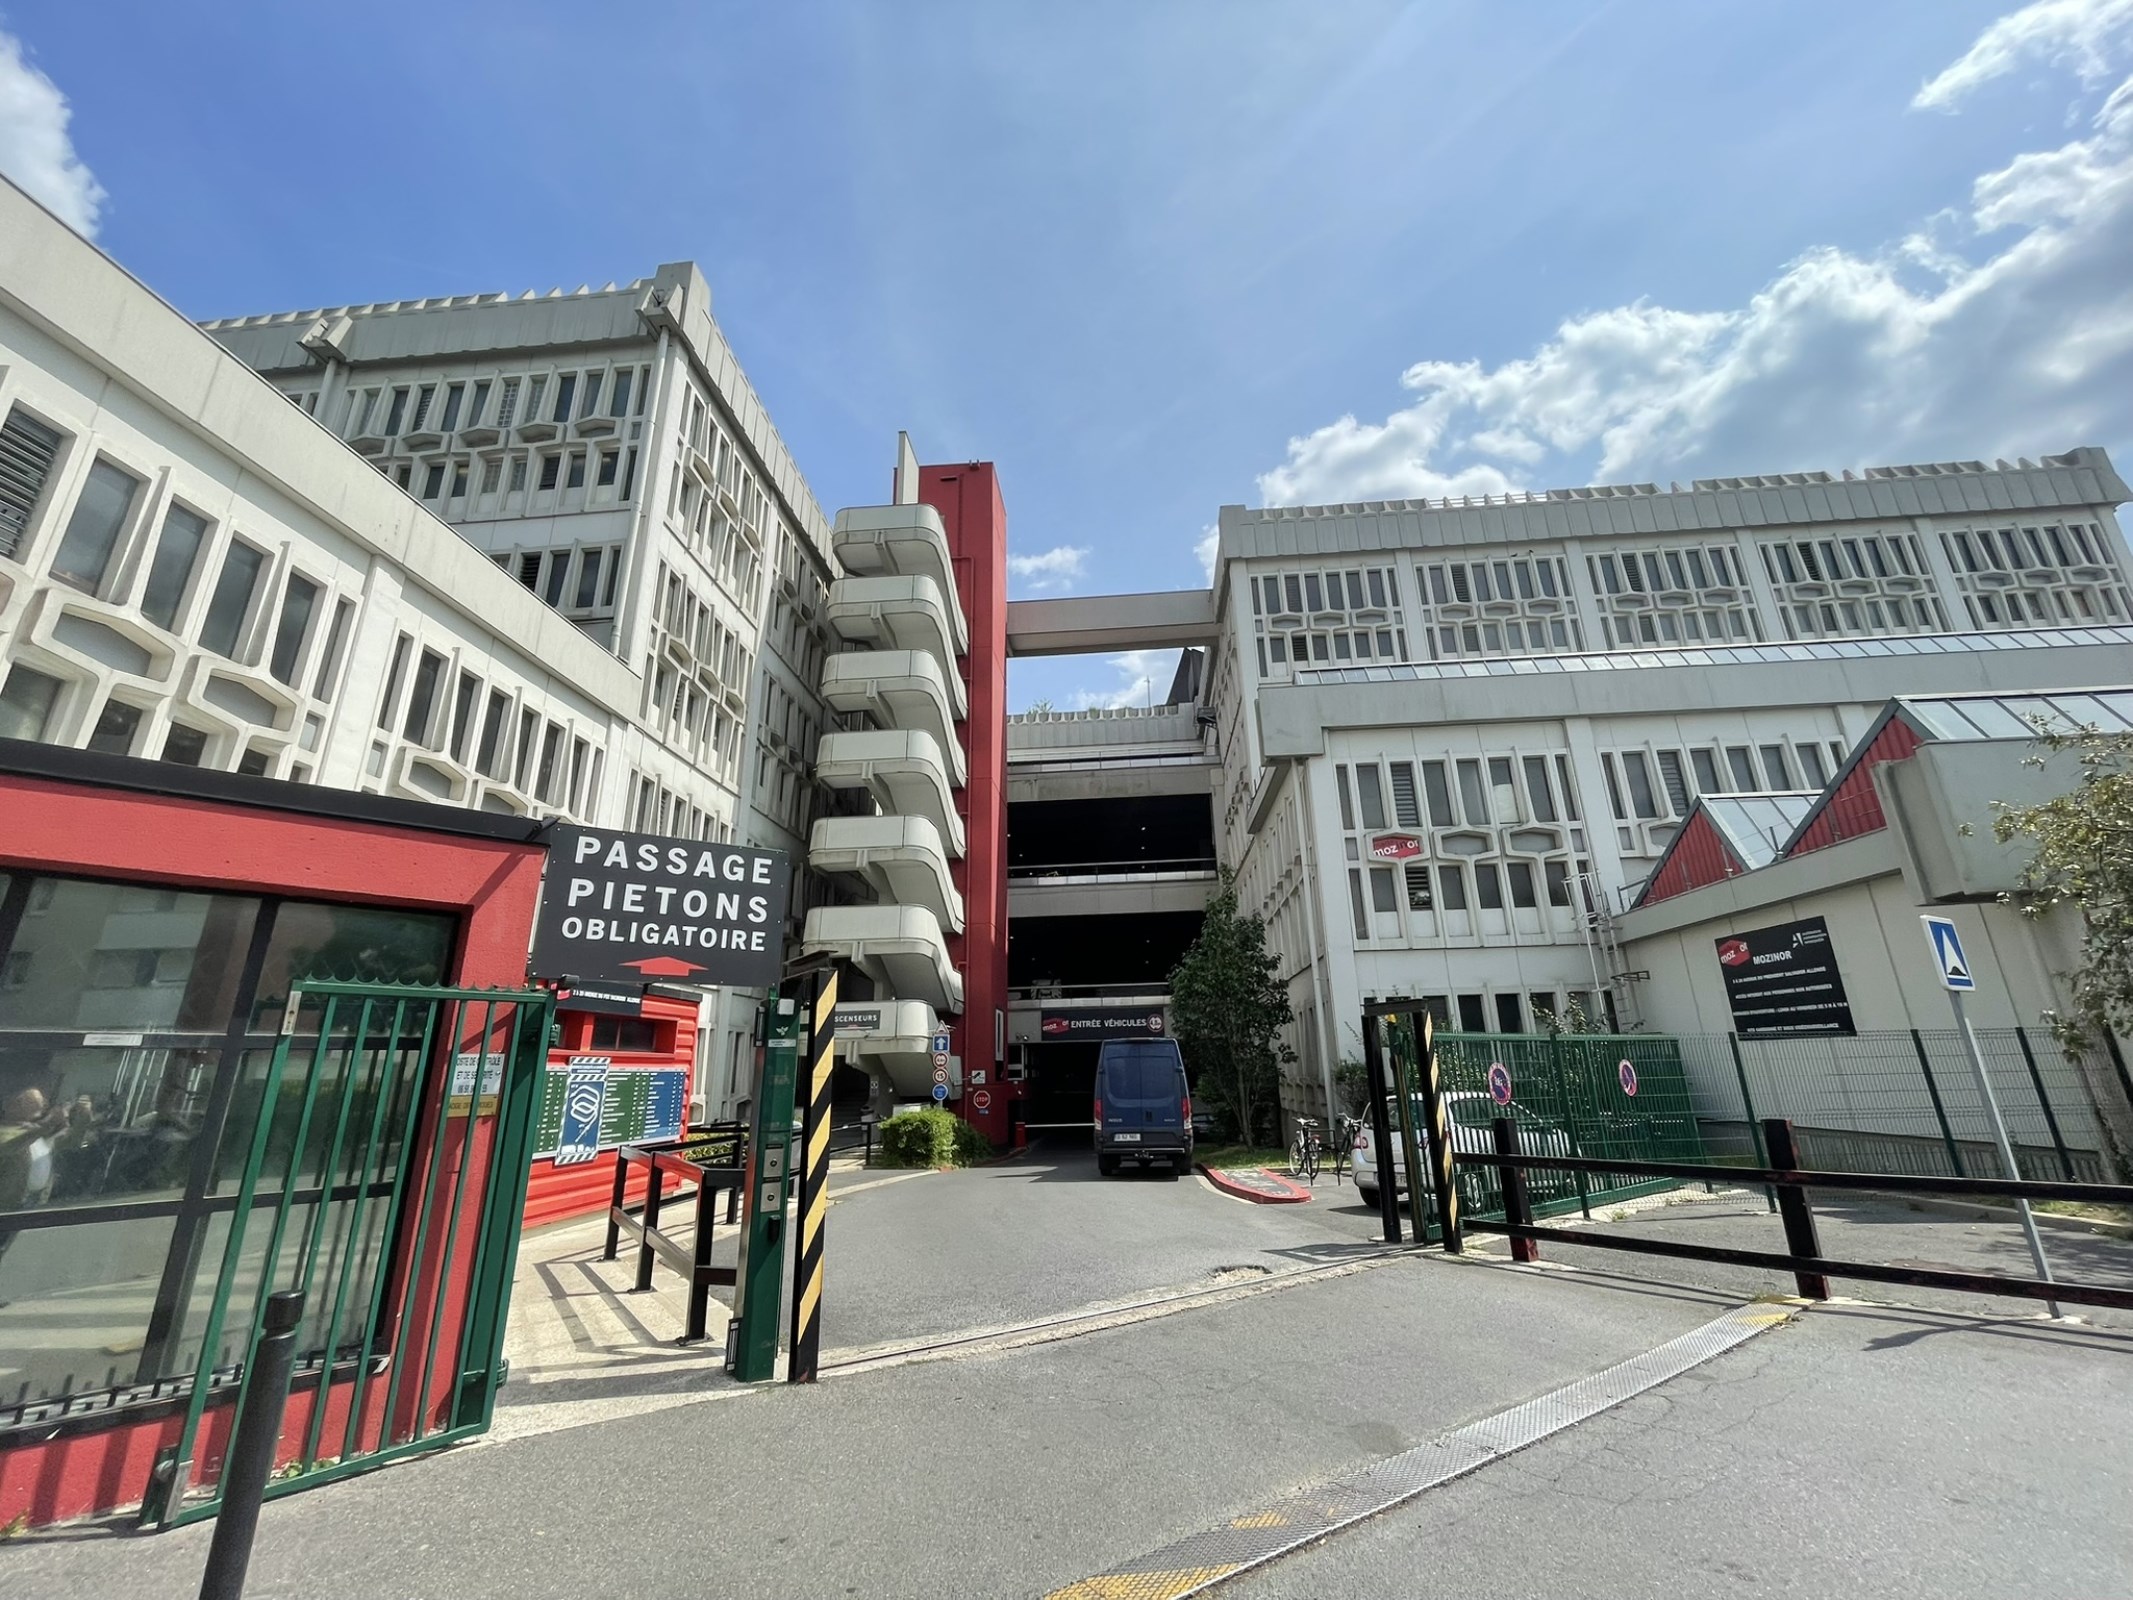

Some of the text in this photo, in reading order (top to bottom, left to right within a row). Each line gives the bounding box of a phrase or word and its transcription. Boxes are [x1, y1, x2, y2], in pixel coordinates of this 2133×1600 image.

[574, 835, 773, 885] PASSAGE
[567, 877, 769, 924] PIETONS
[561, 916, 766, 952] OBLIGATOIRE
[1752, 950, 1792, 965] MOZINOR
[834, 1014, 878, 1023] SCENSEURS
[1070, 1019, 1102, 1029] ENTRÉE
[1104, 1018, 1148, 1028] VÉHICULES
